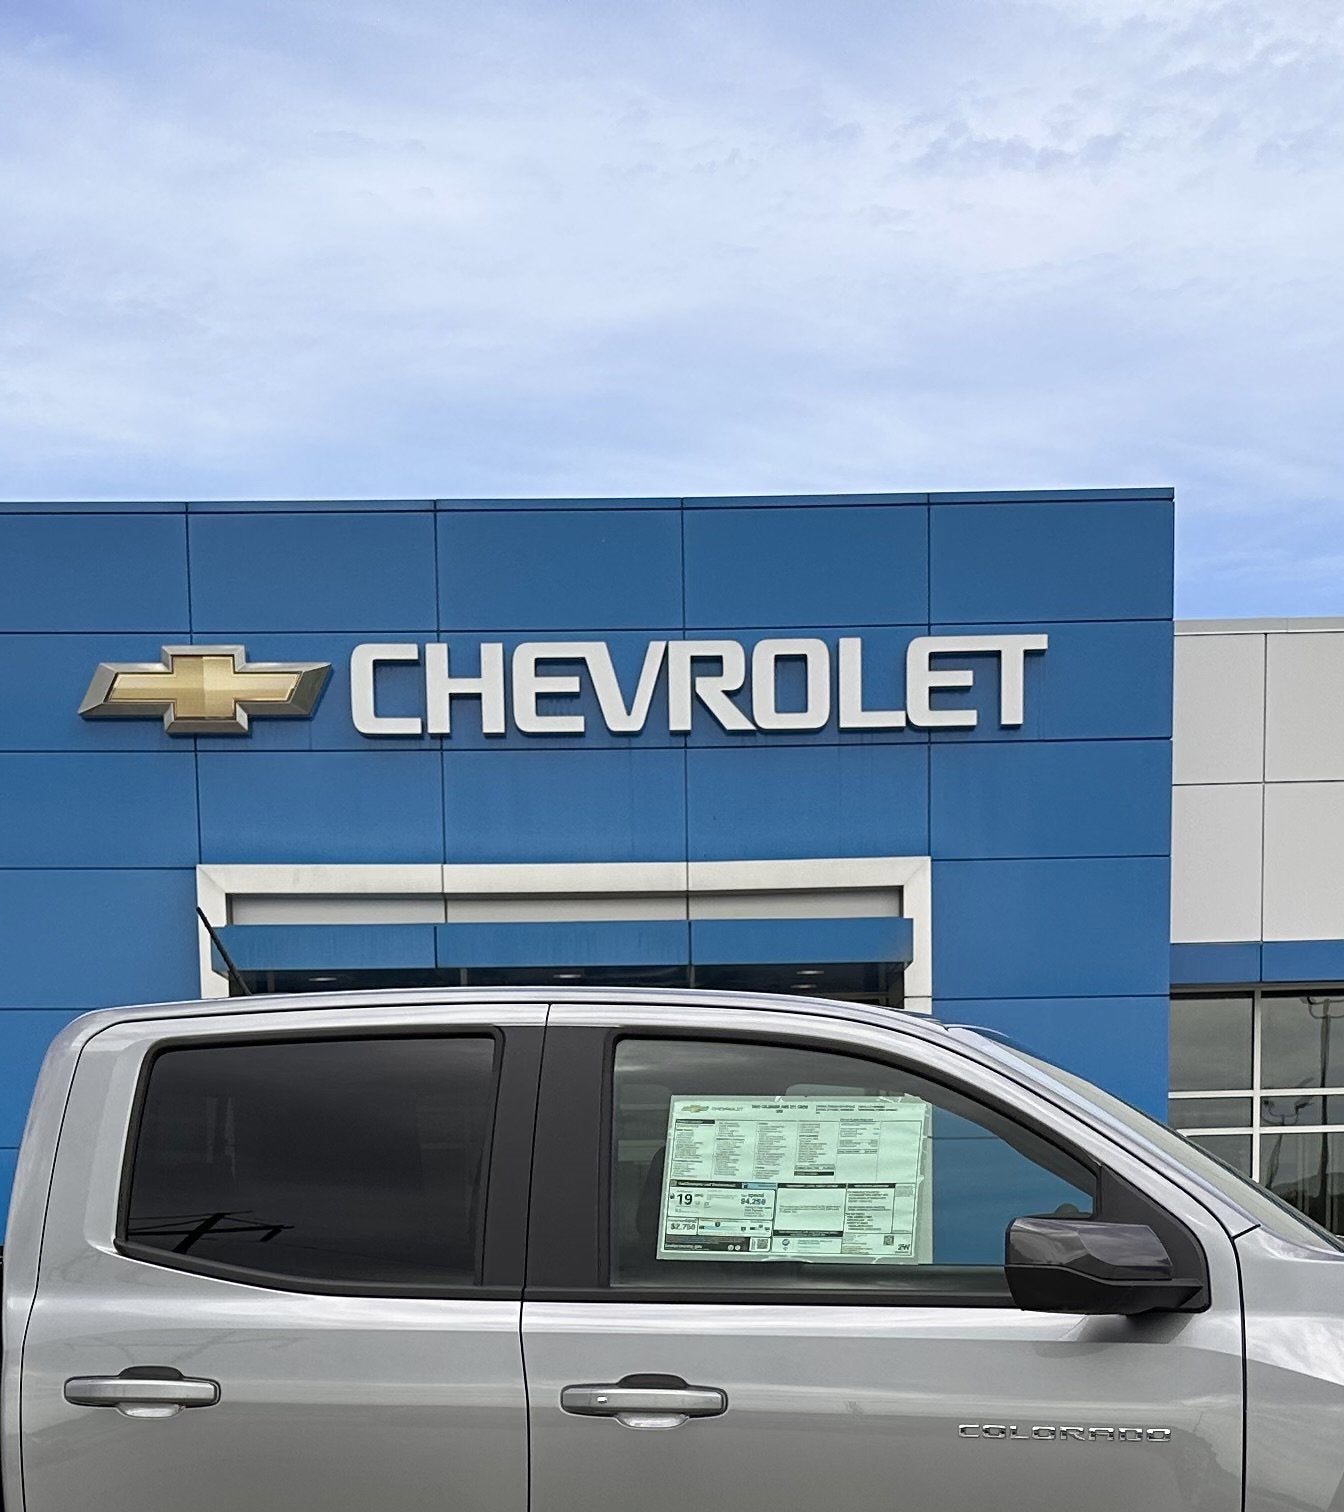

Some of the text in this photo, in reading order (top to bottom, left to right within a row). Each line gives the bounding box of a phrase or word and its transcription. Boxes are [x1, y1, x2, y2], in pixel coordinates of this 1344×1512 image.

[349, 633, 1048, 737] CHEVROLET
[676, 1193, 693, 1206] 19
[958, 1424, 1172, 1443] COLORADO
